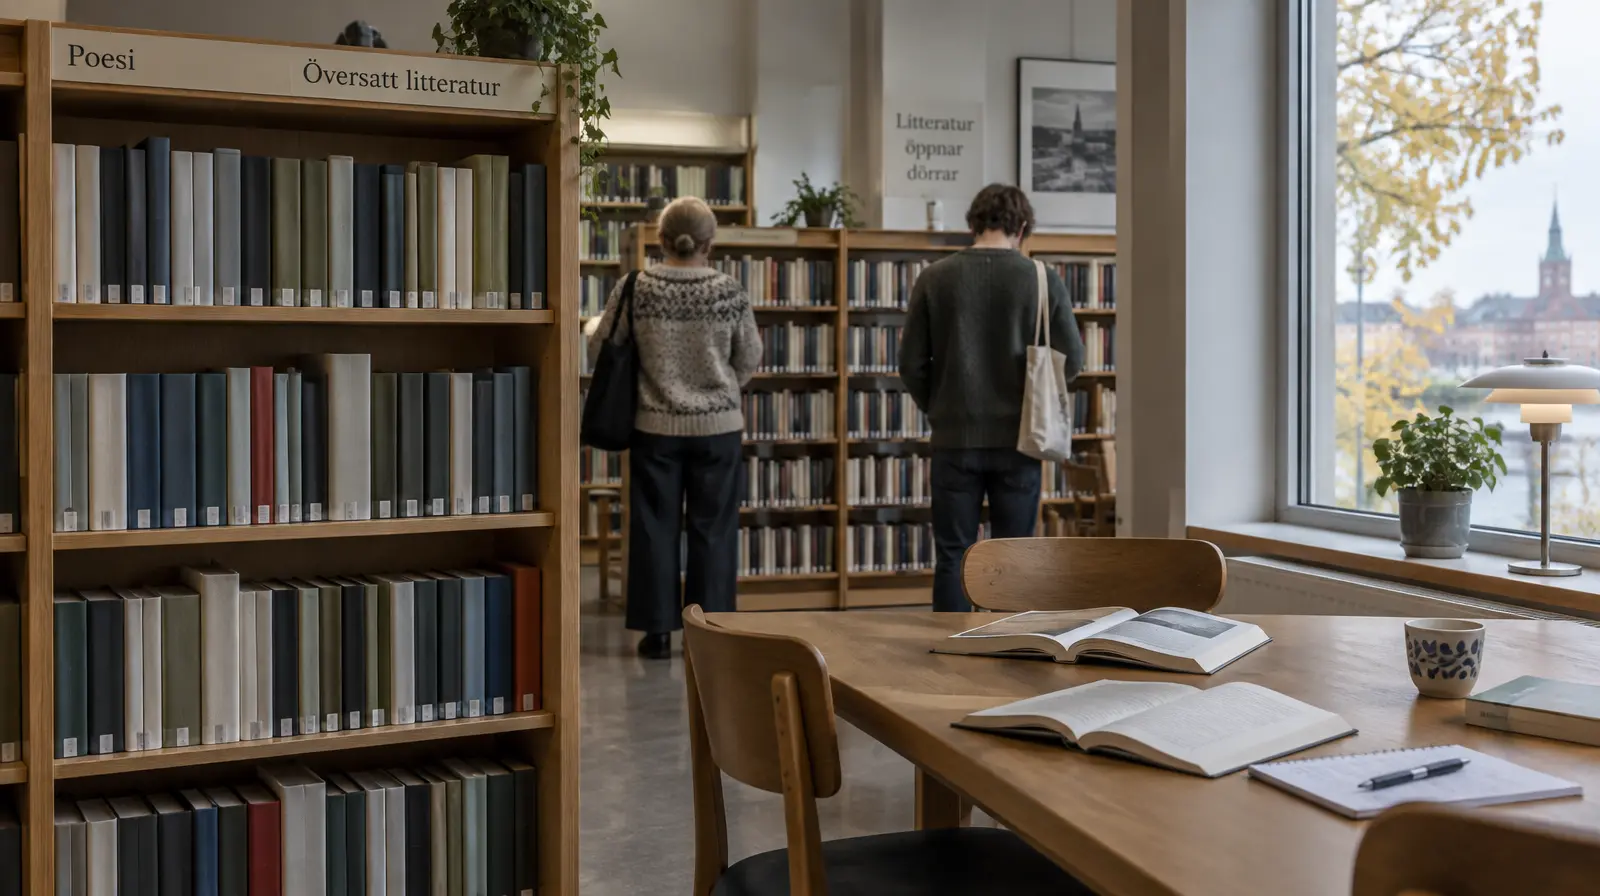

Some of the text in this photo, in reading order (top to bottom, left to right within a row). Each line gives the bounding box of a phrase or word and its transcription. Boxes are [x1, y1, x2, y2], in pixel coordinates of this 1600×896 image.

[68, 44, 135, 70] Poesi
[303, 58, 500, 96] Översatt litteratur
[896, 113, 974, 131] Litteratur
[905, 139, 963, 160] öppnar
[907, 164, 958, 181] dörrar
